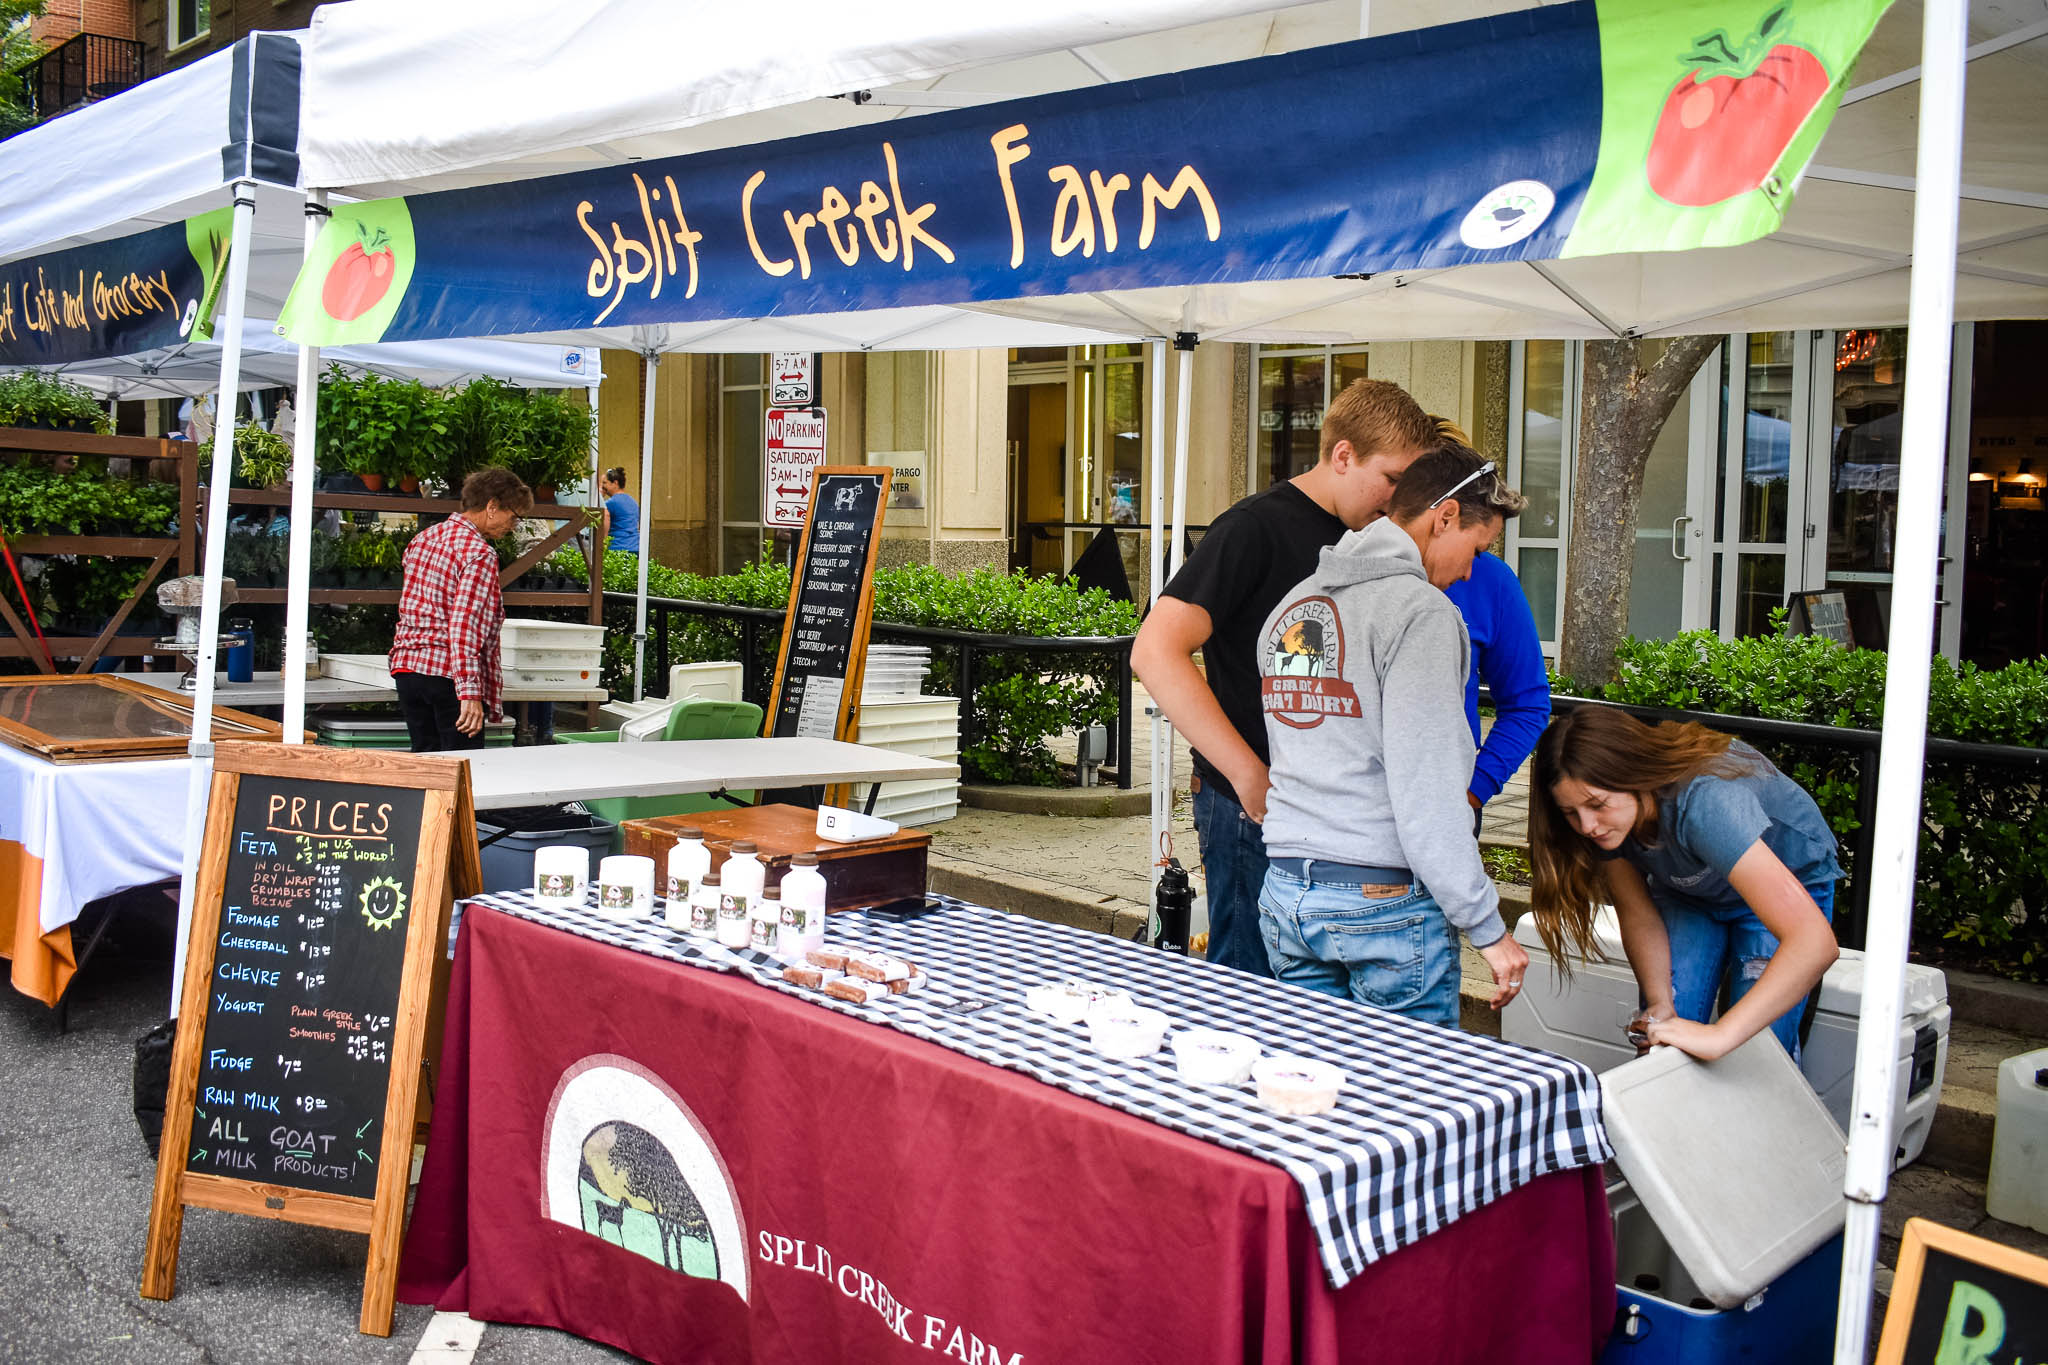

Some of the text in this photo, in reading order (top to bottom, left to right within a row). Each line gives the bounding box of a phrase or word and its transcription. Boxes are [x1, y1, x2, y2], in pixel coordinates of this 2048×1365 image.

[577, 123, 1220, 325] Split Creek Farm
[24, 266, 60, 335] Cafe
[62, 269, 90, 332] and
[93, 270, 180, 321] Grocery
[775, 357, 809, 370] 5-7 A.M.
[768, 418, 822, 441] NO PARKING
[770, 451, 820, 465] SATURDAY
[771, 467, 814, 483] 5AM-1P
[895, 467, 920, 478] FARGO
[889, 482, 910, 493] NTER
[834, 521, 854, 531] CHEDDAR
[863, 529, 868, 539] 4
[813, 543, 837, 553] BLUEBERRY
[859, 545, 864, 554] 4
[810, 557, 850, 568] CHOCOLATE CHIP
[854, 568, 859, 577] 4
[807, 580, 831, 591] SEASONAL
[851, 582, 856, 593] 4
[801, 604, 845, 617] BRAZILIAN CHEESE
[1291, 603, 1330, 622] CREE
[803, 615, 815, 624] PUFF
[843, 618, 850, 628] 2
[797, 630, 821, 640] OAT BERRY
[798, 640, 826, 652] SHORTBREAD
[840, 645, 845, 655] 4
[792, 656, 811, 667] STECCA
[837, 661, 843, 671] 4
[1314, 681, 1323, 694] A
[268, 794, 393, 835] PRICES
[239, 831, 278, 855] FETA
[318, 840, 329, 850] IN
[334, 838, 354, 850] U.S.
[317, 851, 327, 861] IN
[331, 850, 349, 861] THE
[254, 861, 267, 871] IN
[273, 862, 296, 873] OIL
[253, 872, 278, 885] DRY
[285, 875, 317, 886] WRAP
[250, 883, 311, 898] CRUMBLES
[252, 894, 293, 908] BRINE
[227, 905, 281, 929] FROMAGE
[220, 931, 289, 955] CHEESEBALL
[218, 962, 281, 987] CHEVRE
[216, 992, 265, 1015] YOGURT
[290, 1005, 318, 1017] PLAIN
[322, 1008, 354, 1021] GREEK
[335, 1020, 361, 1031] STYLE
[289, 1026, 337, 1042] SMOOTHIES
[372, 1040, 385, 1050] SM
[210, 1048, 254, 1073] FUDGE
[373, 1051, 385, 1063] LG
[205, 1086, 235, 1105] RAW
[244, 1091, 281, 1115] MILK
[208, 1116, 337, 1153] ALL GOAT
[215, 1149, 357, 1184] MILK PRODUCTS!
[837, 1264, 914, 1344] CREEK
